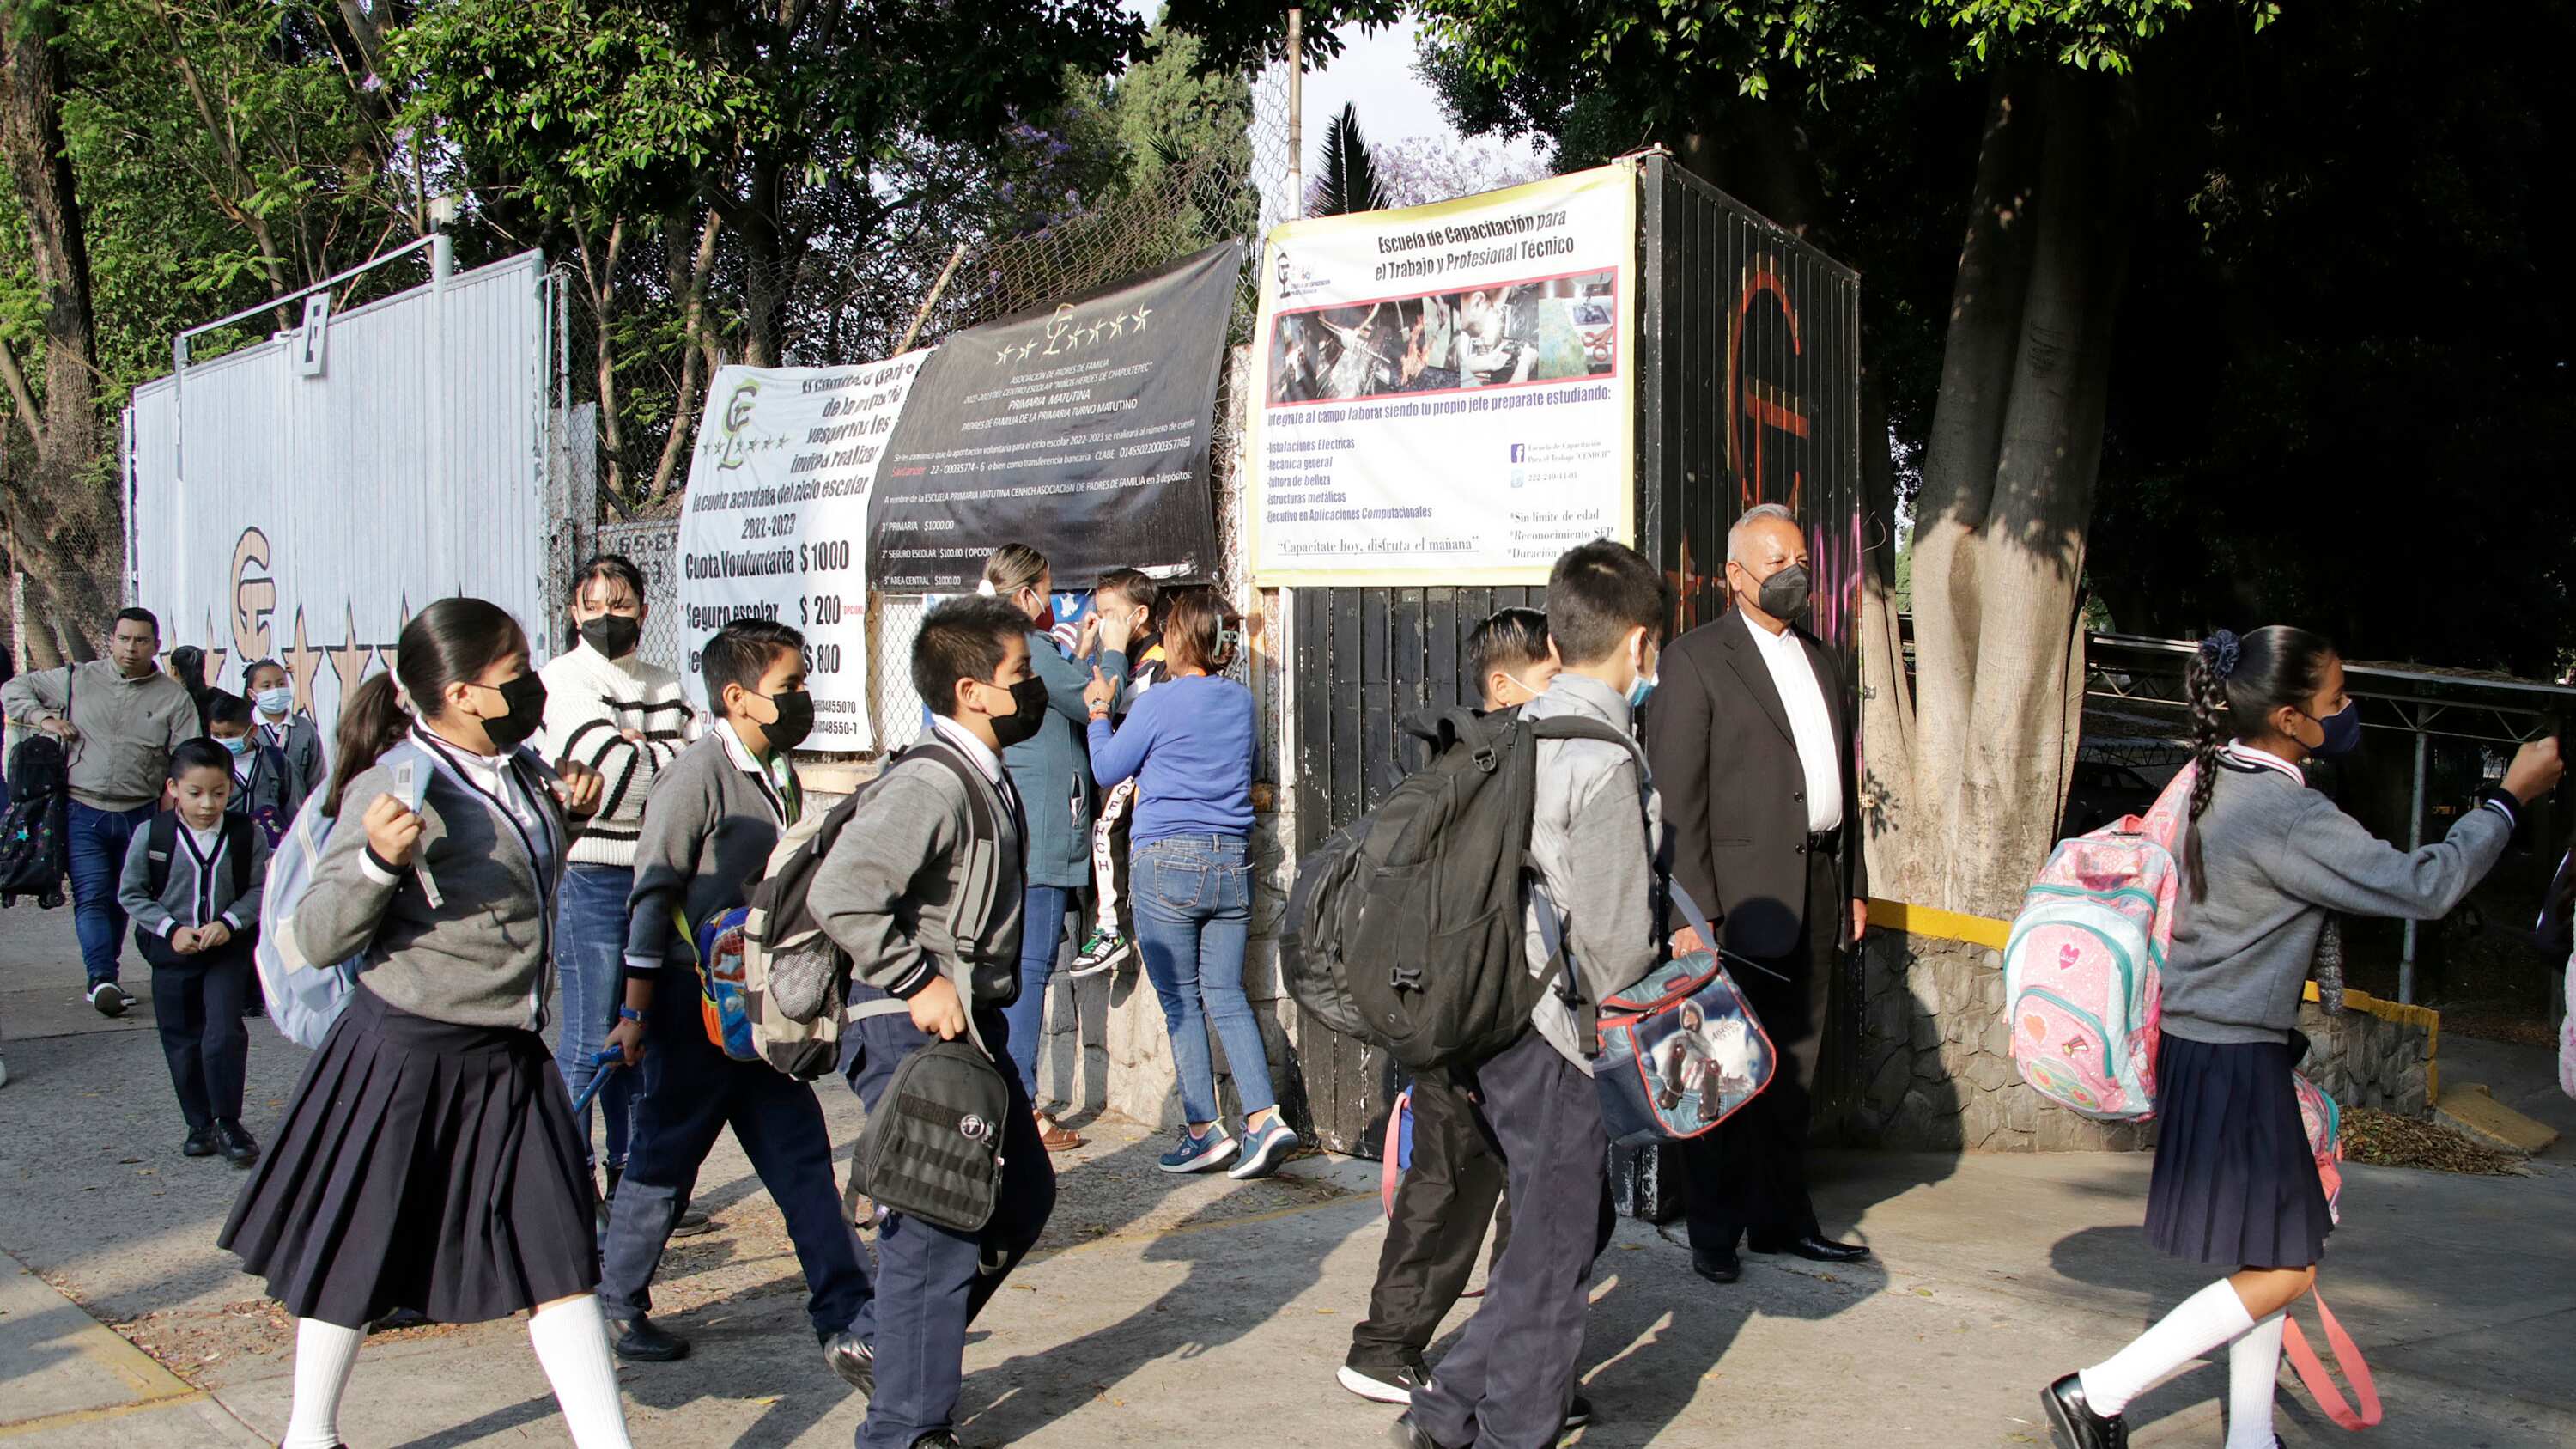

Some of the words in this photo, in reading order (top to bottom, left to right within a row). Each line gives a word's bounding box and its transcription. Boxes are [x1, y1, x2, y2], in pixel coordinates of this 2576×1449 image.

[1378, 232, 1425, 254] Escuela
[1427, 228, 1444, 247] de
[1445, 214, 1534, 243] Capacitación
[1535, 210, 1567, 232] para
[1376, 264, 1387, 282] el
[1388, 259, 1434, 279] Trabajo
[1437, 257, 1444, 275] y
[1446, 243, 1517, 271] Profesional
[1521, 236, 1575, 259] Técnico
[822, 398, 841, 417] de
[1008, 396, 1046, 411] PRIMARIA
[1048, 389, 1091, 406] MATUTINA
[1305, 410, 1315, 423] al
[1317, 408, 1346, 423] campo
[1348, 406, 1382, 421] laborar
[1385, 402, 1419, 419] siendo
[1421, 401, 1431, 416] tu
[1433, 398, 1466, 416] propio
[1492, 392, 1544, 411] preparate
[1546, 384, 1611, 405] estudiando:
[993, 416, 1018, 428] FAMILIA
[1018, 413, 1028, 423] DE
[1037, 408, 1071, 422] PRIMARIA
[1072, 404, 1097, 417] TURNO
[1097, 398, 1138, 414] MATUTINO
[870, 414, 891, 435] les
[1169, 421, 1177, 431] de
[830, 445, 880, 468] realizar
[1094, 449, 1115, 461] CLABE
[1303, 456, 1333, 471] general
[925, 492, 949, 502] ESCUELA
[950, 490, 979, 501] PRIMARIA
[1076, 482, 1084, 492] DE
[1087, 480, 1109, 491] PADRES
[1119, 475, 1145, 488] FAMILIA
[1146, 476, 1155, 484] en
[1292, 474, 1303, 487] de
[701, 491, 729, 513] cuota
[777, 481, 794, 504] del
[822, 474, 870, 498] escolar
[1309, 508, 1360, 523] Aplicaciones
[1362, 505, 1433, 521] Computacionales
[1563, 509, 1573, 521] de
[1577, 508, 1599, 521] edad
[889, 521, 918, 531] PRIMARIA
[888, 549, 911, 559] SEGURO
[912, 549, 937, 558] ESCOLAR
[1367, 538, 1411, 551] disfruta
[1414, 537, 1425, 551] el
[685, 552, 721, 581] Cuota
[800, 540, 808, 575] $
[811, 539, 850, 572] 1000
[905, 575, 930, 586] CENTRAL
[687, 601, 730, 632] Seguro
[799, 594, 808, 628] $
[814, 594, 841, 625] 200
[817, 643, 841, 674] 800
